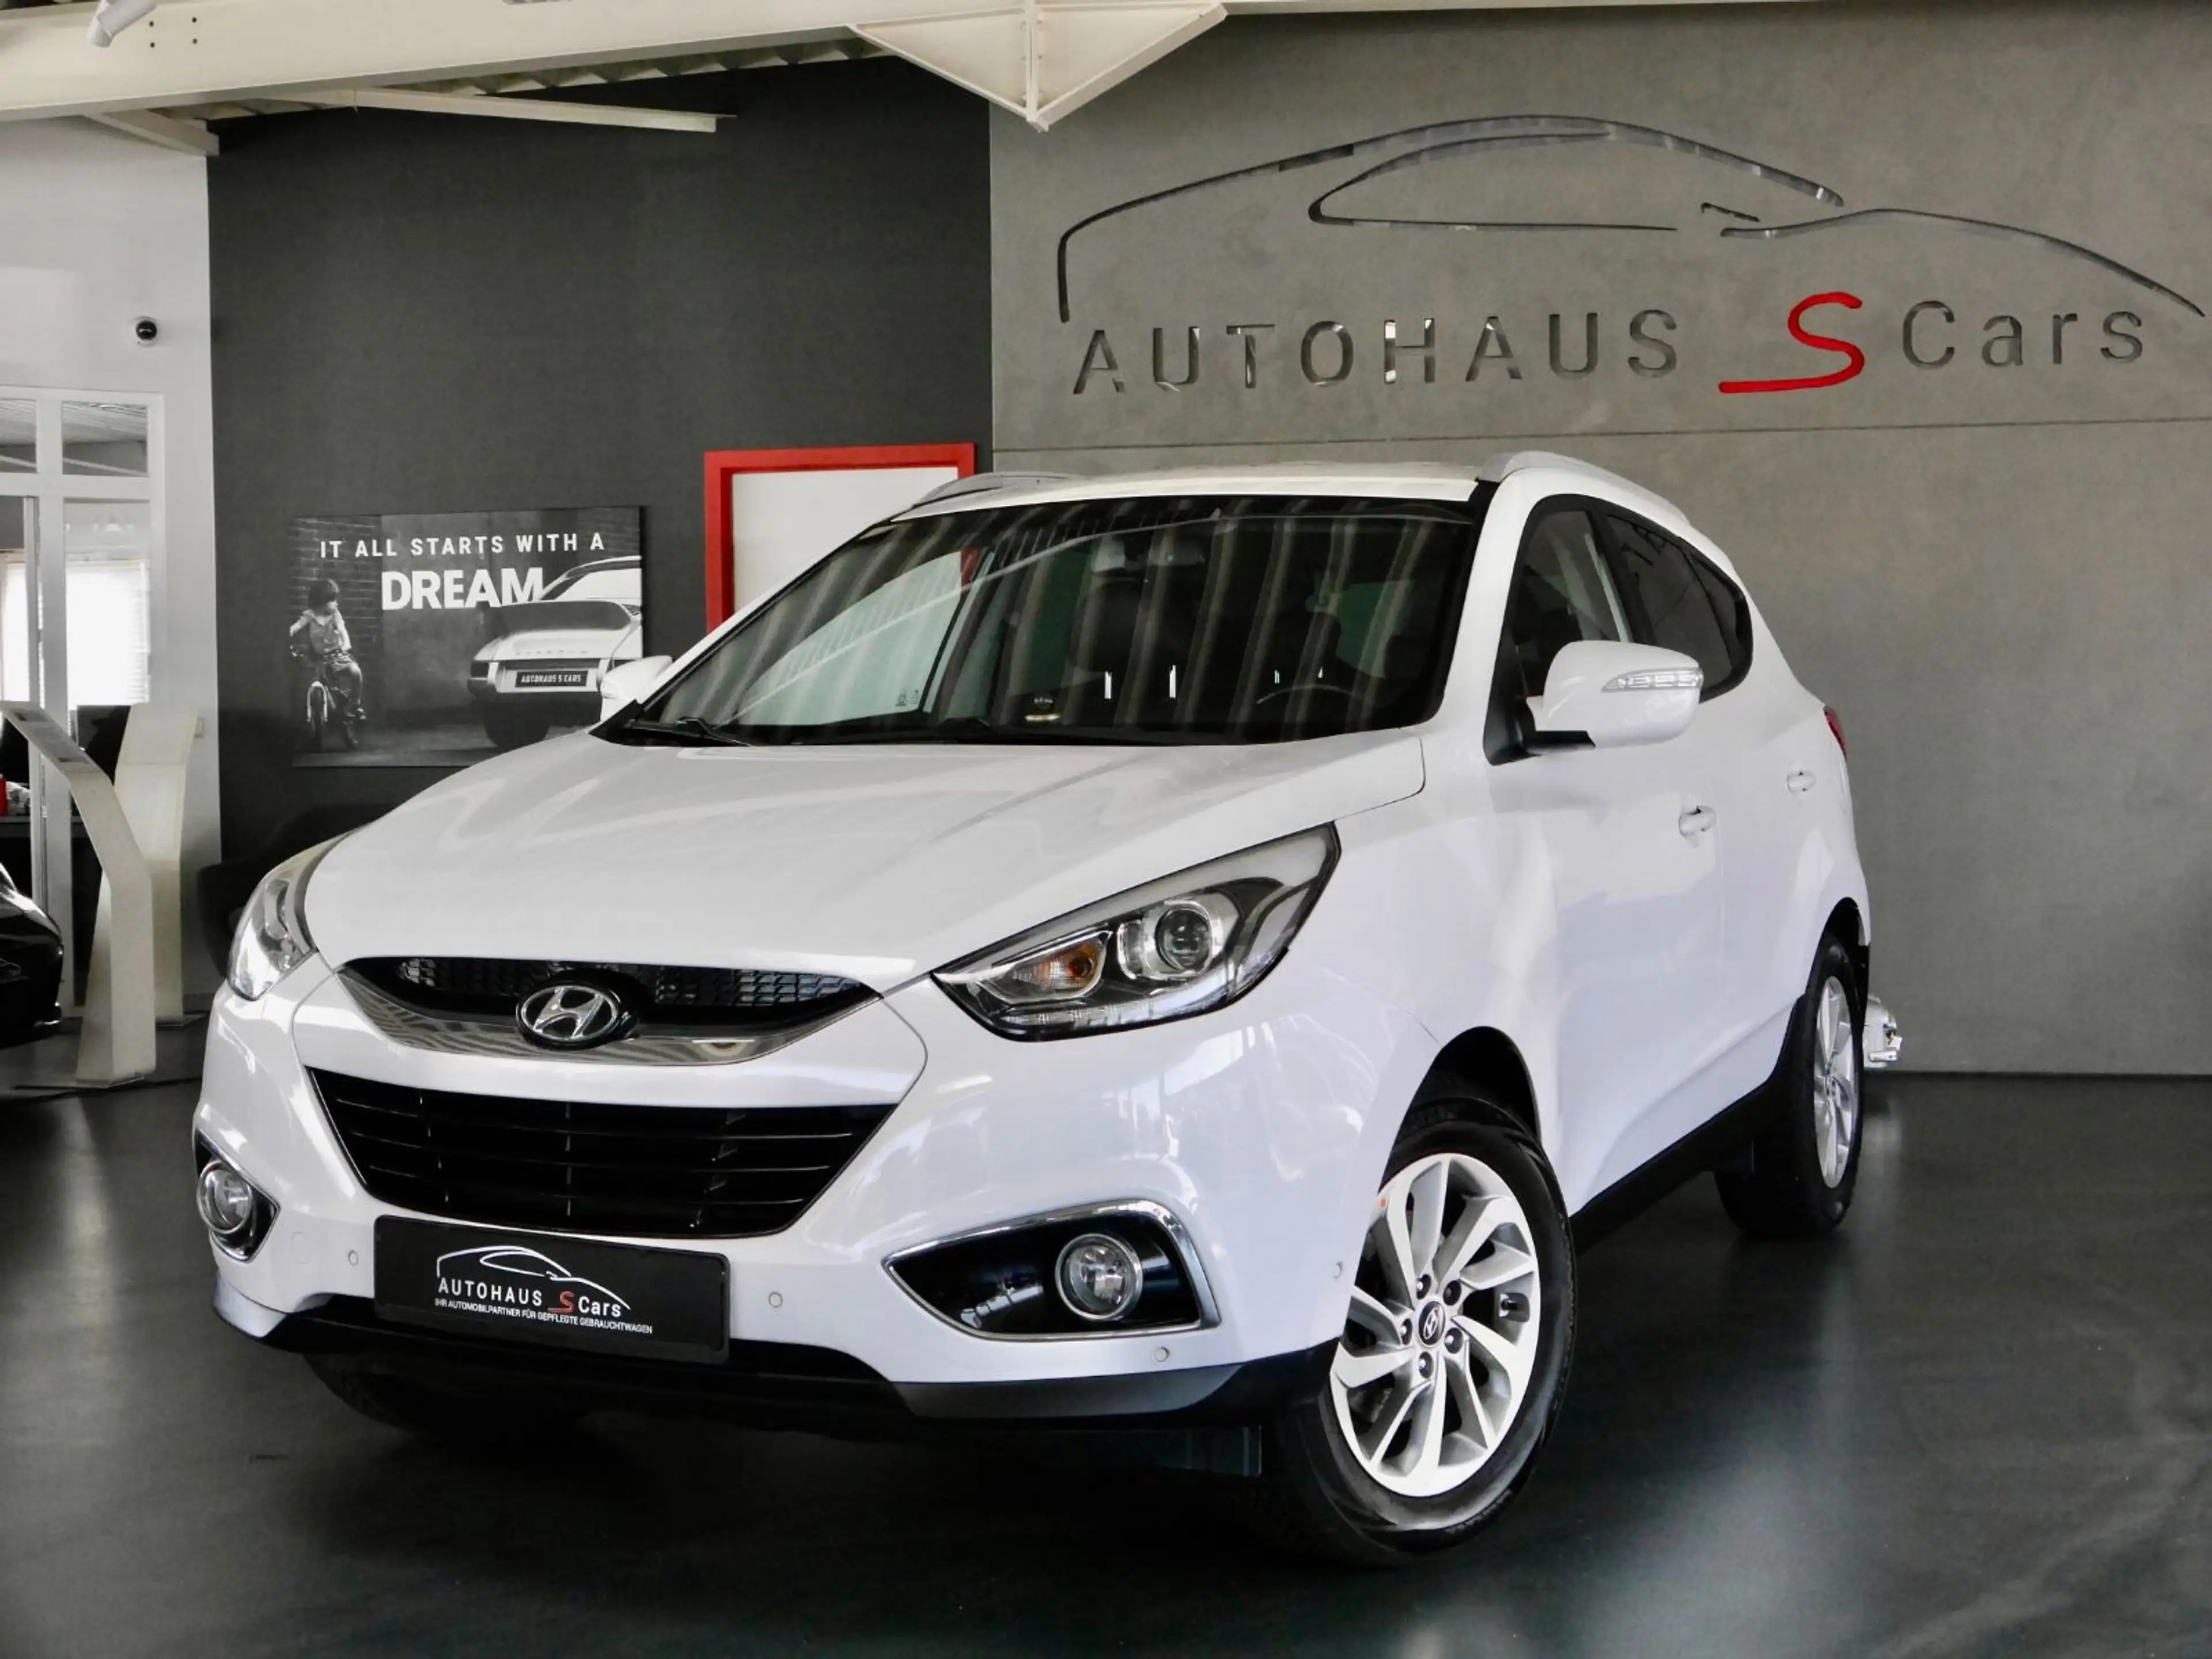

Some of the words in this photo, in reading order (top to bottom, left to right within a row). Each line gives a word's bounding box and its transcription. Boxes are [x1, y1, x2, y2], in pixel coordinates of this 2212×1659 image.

[1073, 309, 1677, 395] AUTOHAUS
[1718, 291, 1864, 393] S
[1902, 300, 2143, 369] Cars
[320, 540, 342, 558] IT
[355, 539, 397, 557] ALL
[411, 536, 503, 556] STARTS
[517, 533, 577, 553] WITH
[590, 532, 604, 551] A
[381, 567, 544, 611] DREAM
[564, 674, 582, 683] CARS
[435, 1298, 447, 1308] IHR
[448, 1300, 521, 1317] AUTOMOBILPARTNER
[521, 1308, 536, 1320] FÜR
[537, 1312, 578, 1325] GEPFLEGTE
[579, 1317, 653, 1334] GEBRAUCHTWAGEN
[438, 1277, 542, 1306] AUTOHAUS
[548, 1290, 575, 1313] S
[578, 1296, 622, 1317] Cars
